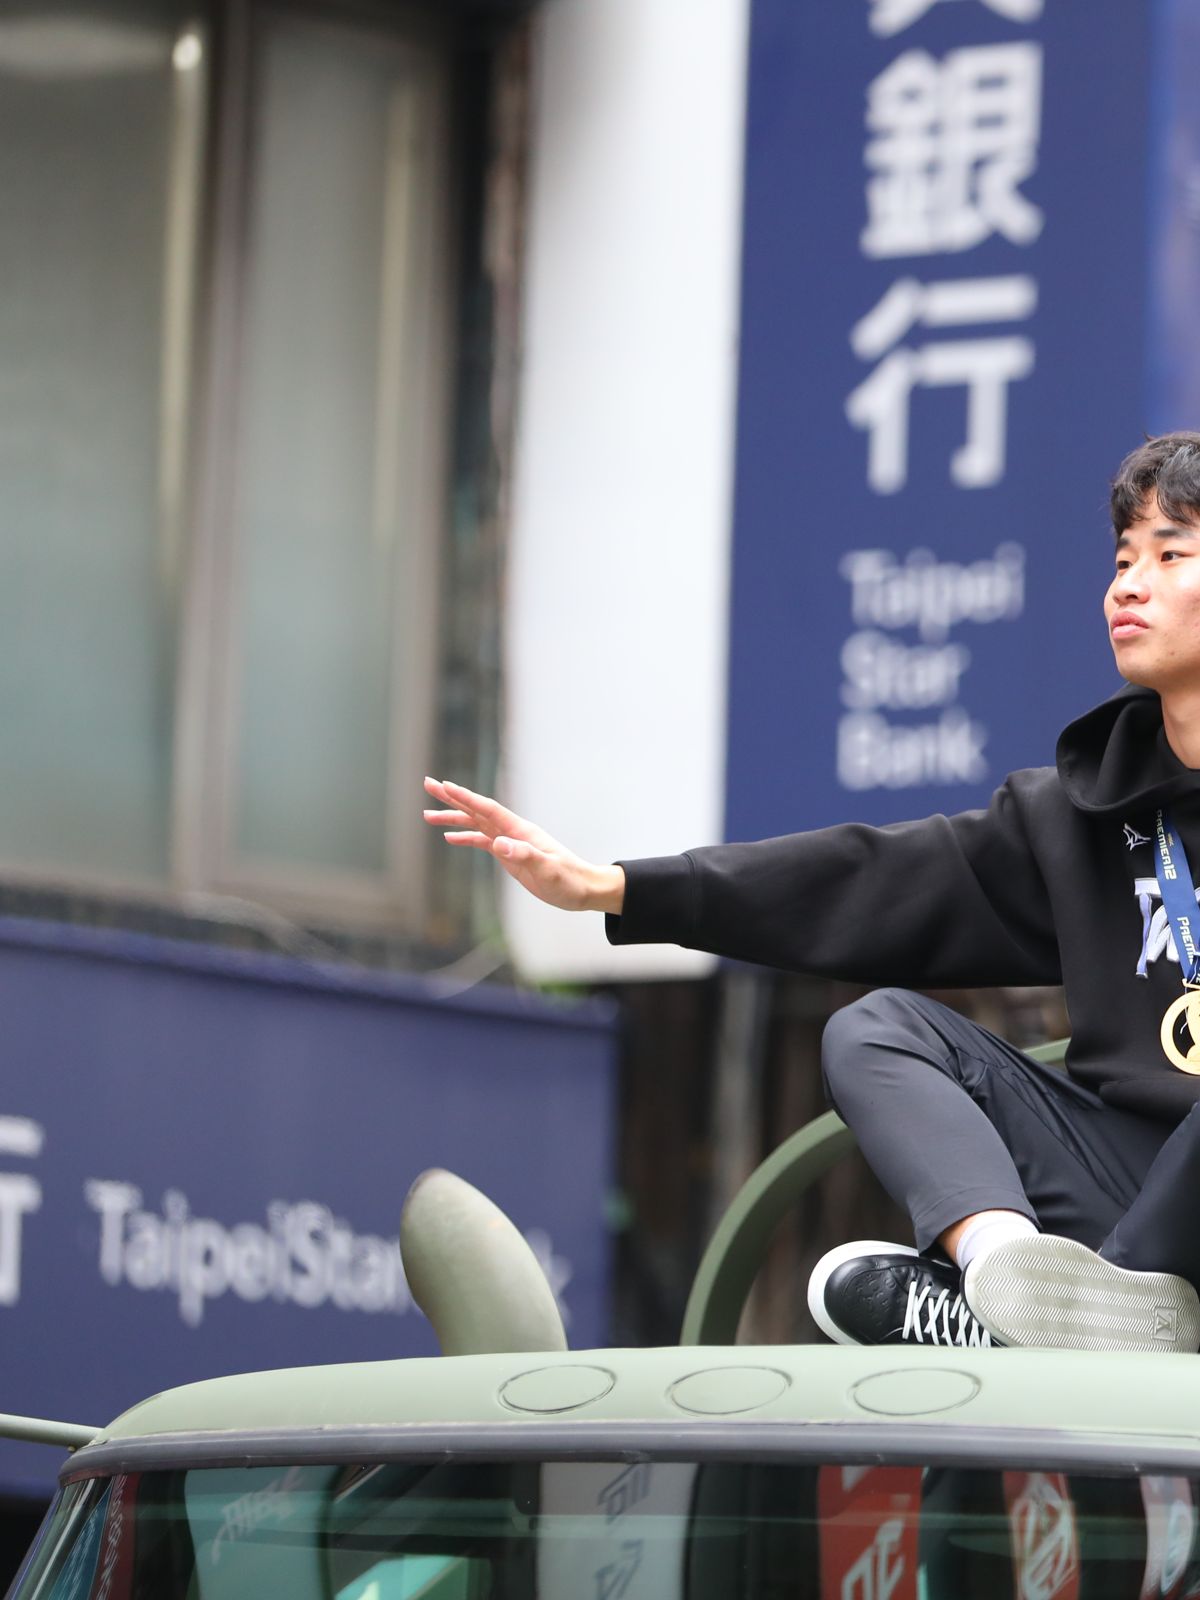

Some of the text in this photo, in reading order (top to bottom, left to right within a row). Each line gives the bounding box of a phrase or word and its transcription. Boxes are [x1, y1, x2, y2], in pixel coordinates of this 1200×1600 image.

[845, 0, 1045, 496] 銀行
[841, 543, 1024, 643] Taipei
[841, 630, 970, 708] Star
[838, 706, 987, 790] Bank
